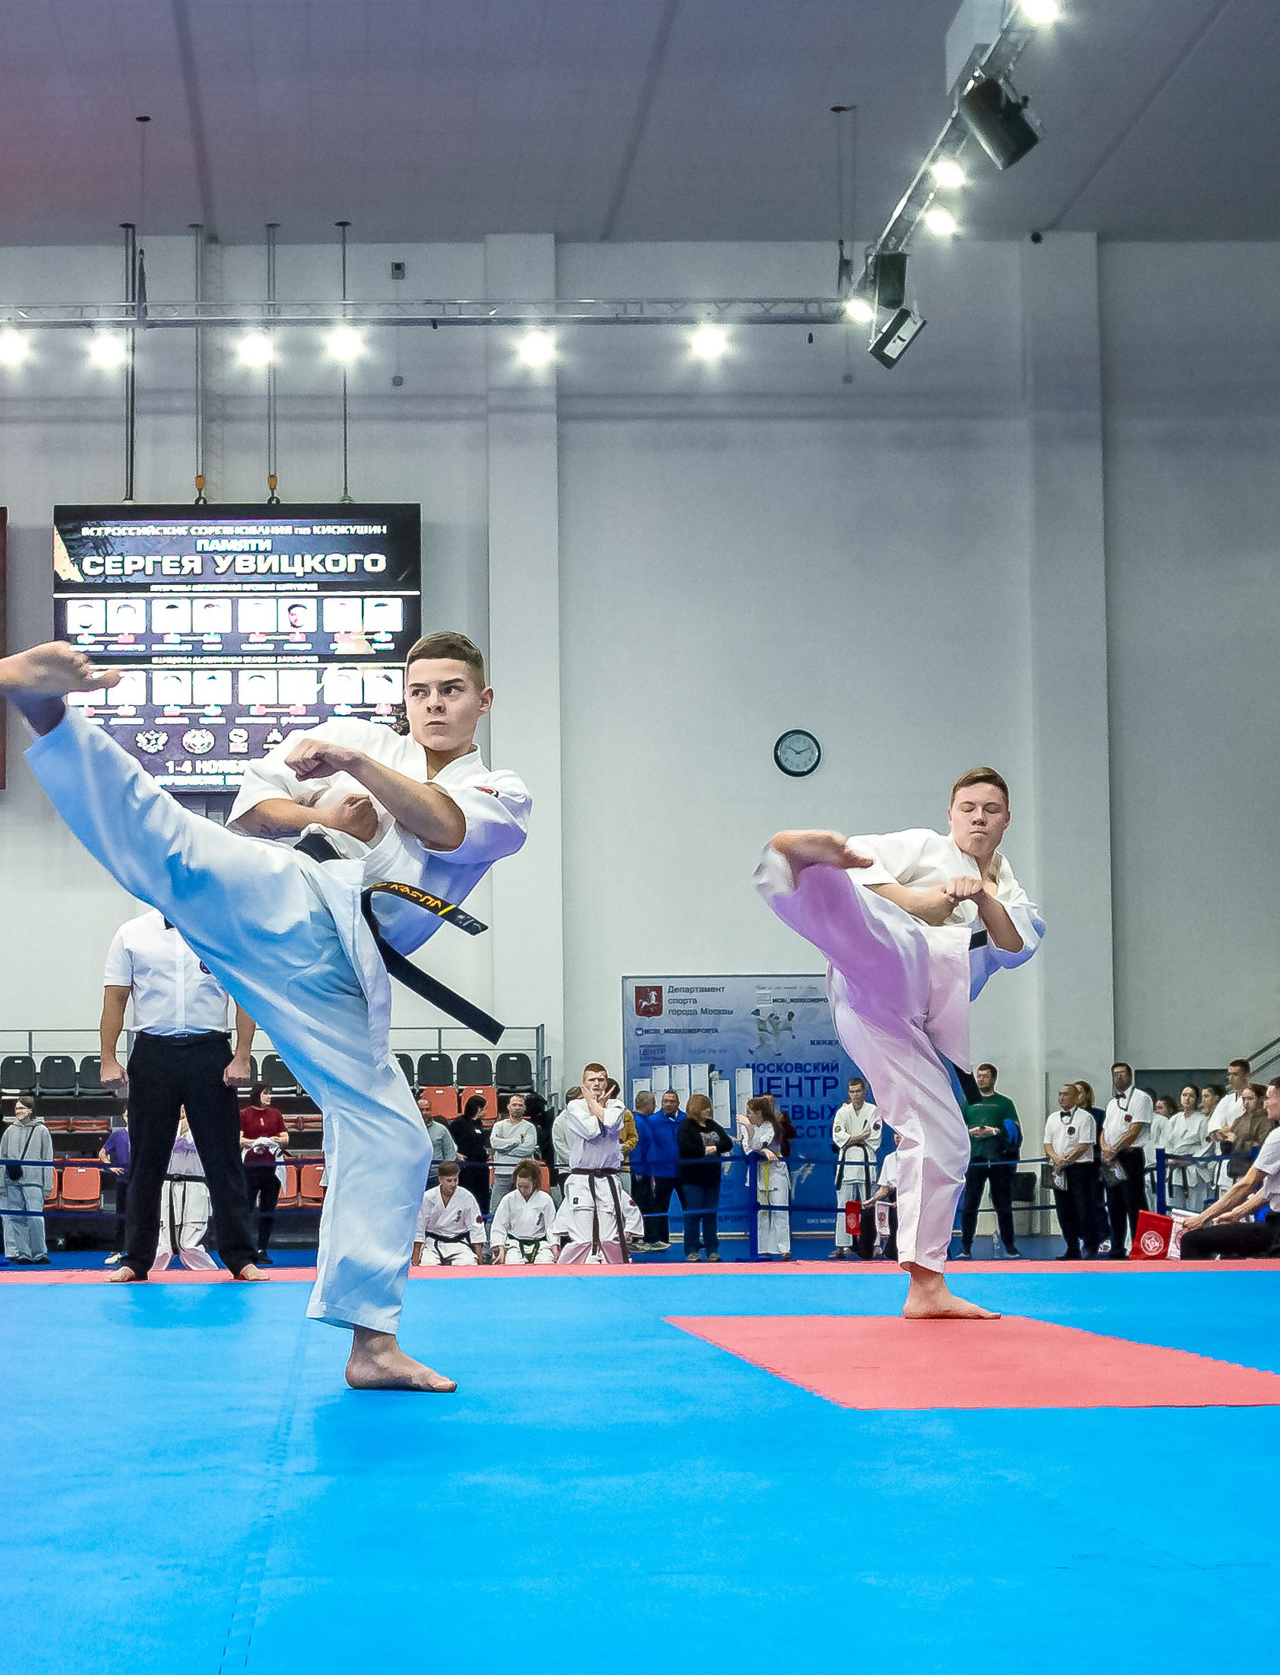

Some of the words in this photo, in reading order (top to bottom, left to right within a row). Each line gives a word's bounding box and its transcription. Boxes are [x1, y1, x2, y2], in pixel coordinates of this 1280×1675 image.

[196, 538, 272, 552] ПАМЯТИ
[81, 555, 203, 576] СЕРГЕЯ
[213, 553, 387, 577] УВИЦКОГО
[667, 985, 726, 994] Департамент
[667, 998, 698, 1006] спорта
[668, 1008, 698, 1016] города
[700, 1007, 734, 1016] Москвы
